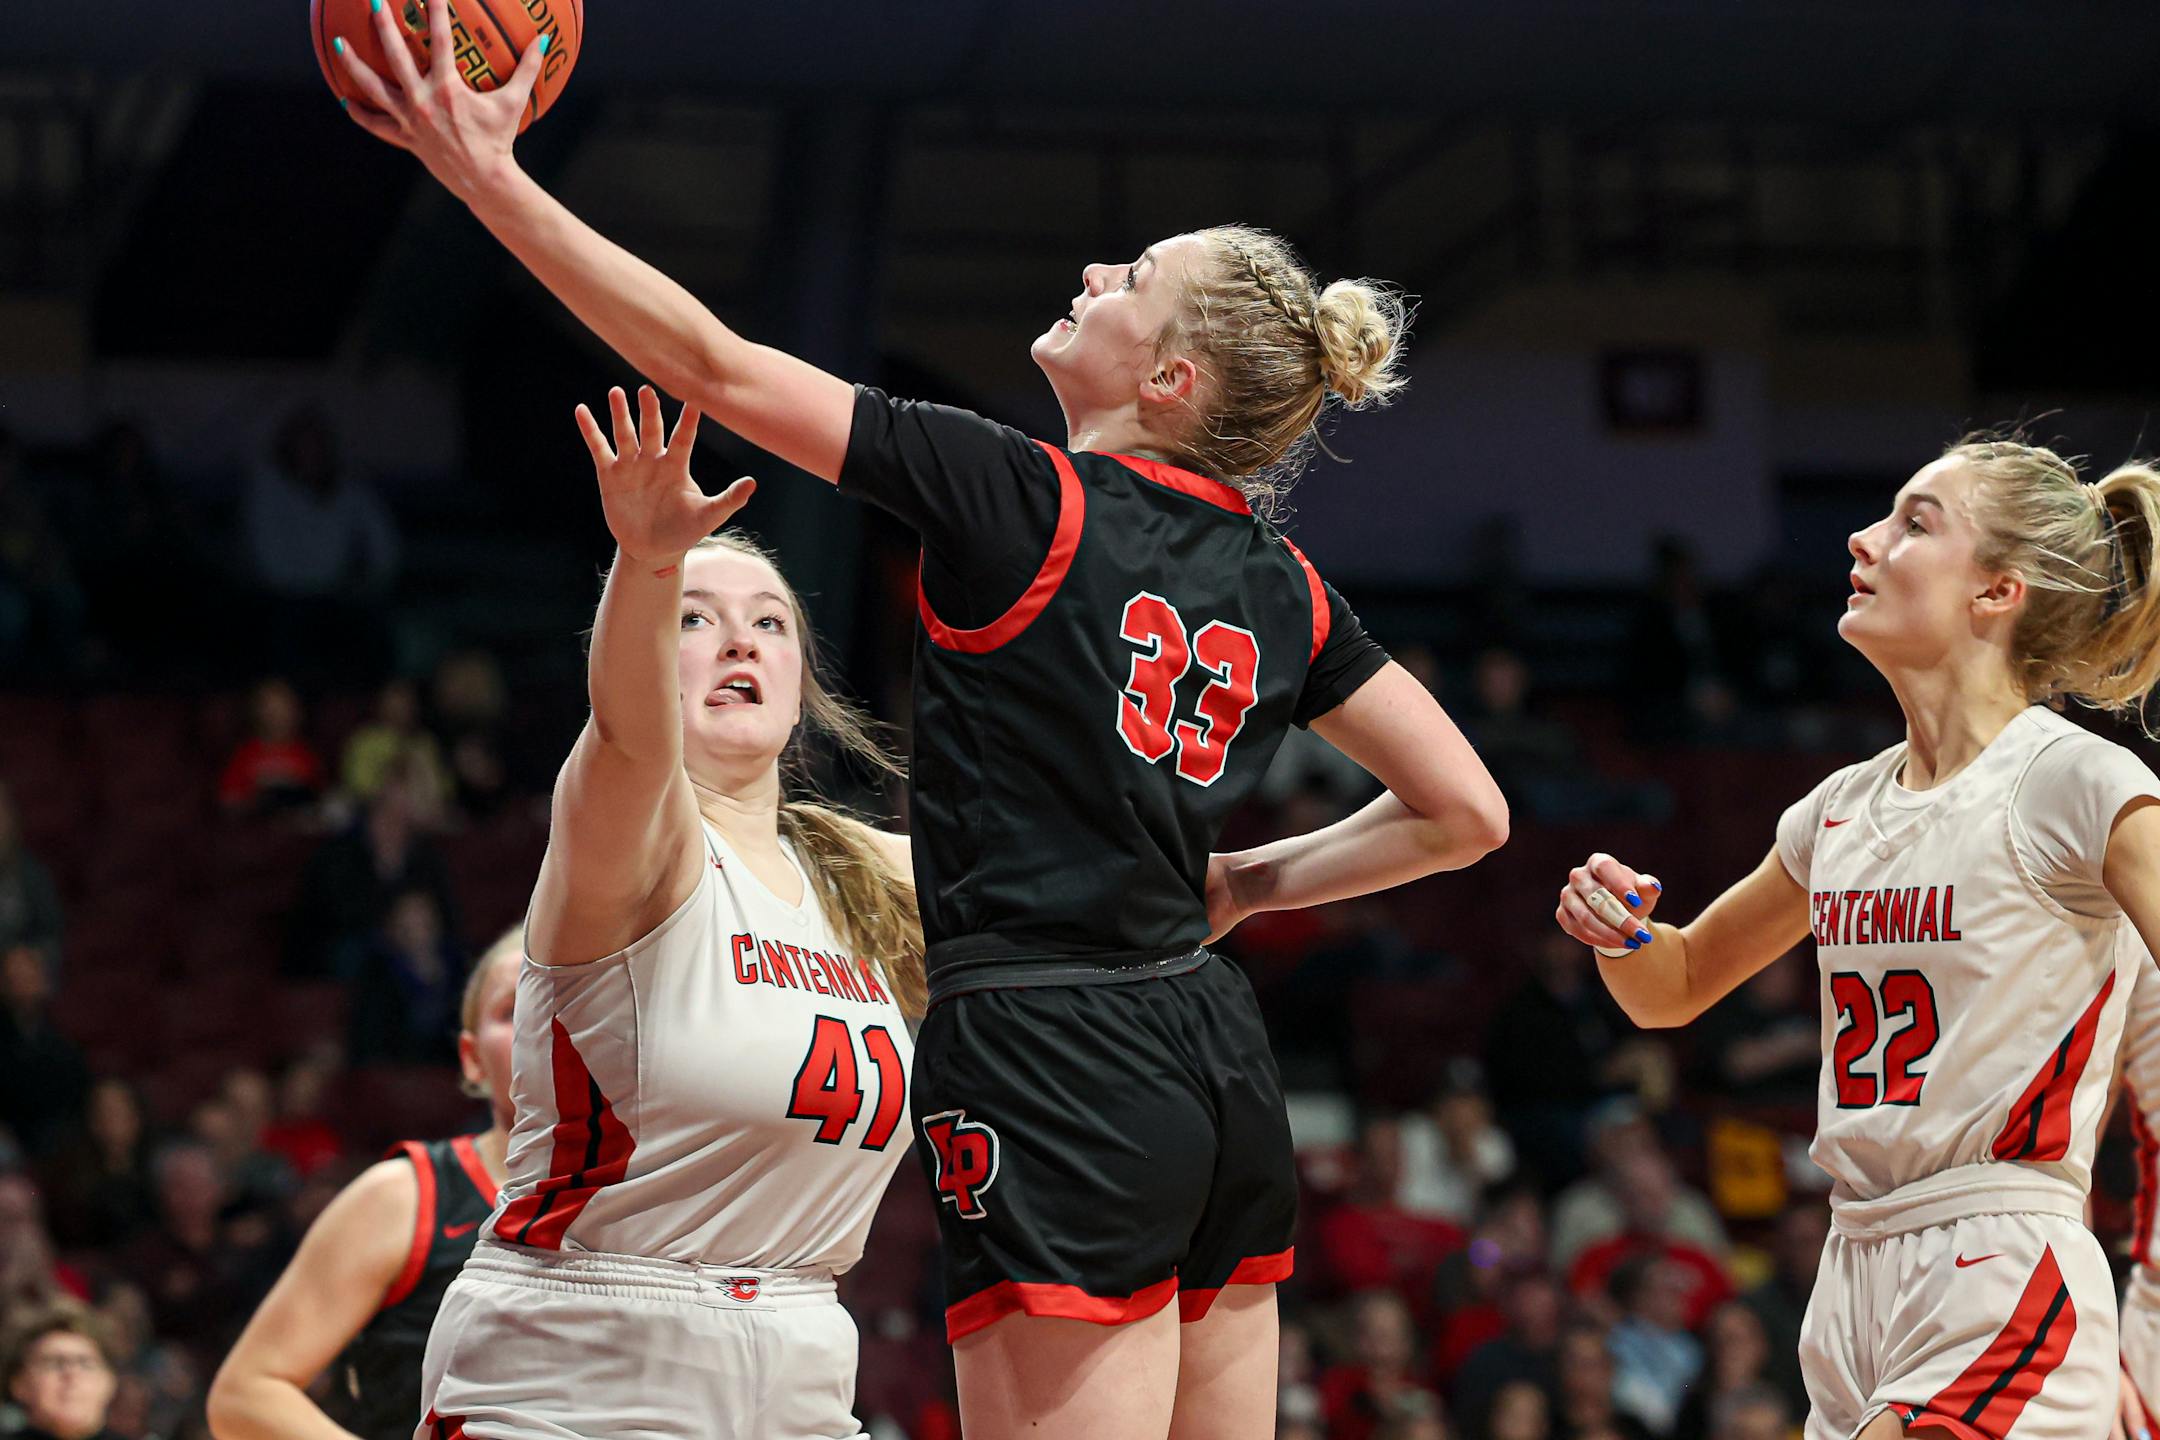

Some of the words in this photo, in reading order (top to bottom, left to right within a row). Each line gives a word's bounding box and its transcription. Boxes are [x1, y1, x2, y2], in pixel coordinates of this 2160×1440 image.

[520, 0, 568, 82] DING
[1116, 590, 1260, 788] 33
[1813, 885, 1961, 946] CENTENNIAL
[785, 1014, 906, 1152] 41
[1830, 969, 1940, 1109] 22
